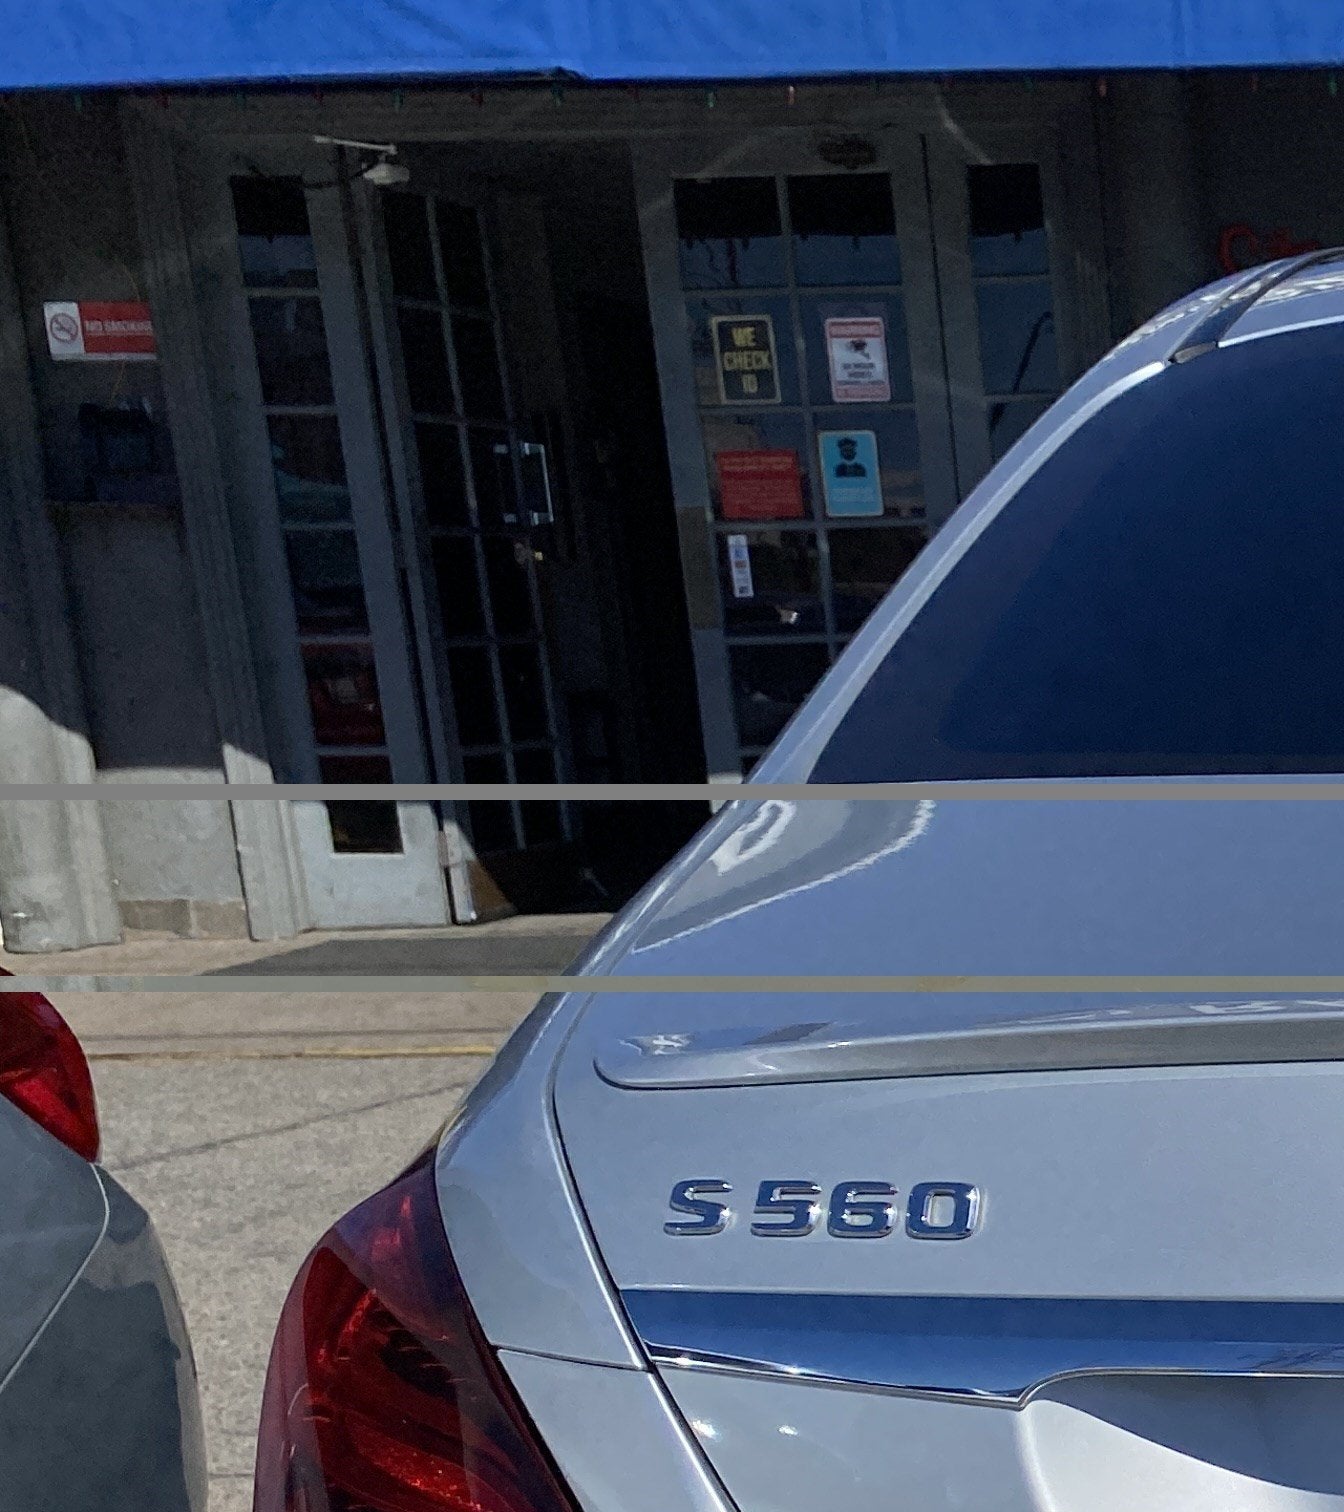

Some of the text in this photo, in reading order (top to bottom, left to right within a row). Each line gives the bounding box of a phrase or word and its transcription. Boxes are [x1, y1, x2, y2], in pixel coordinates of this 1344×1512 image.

[731, 327, 756, 347] WE
[723, 350, 772, 371] CHECK
[663, 1178, 983, 1240] S 560
